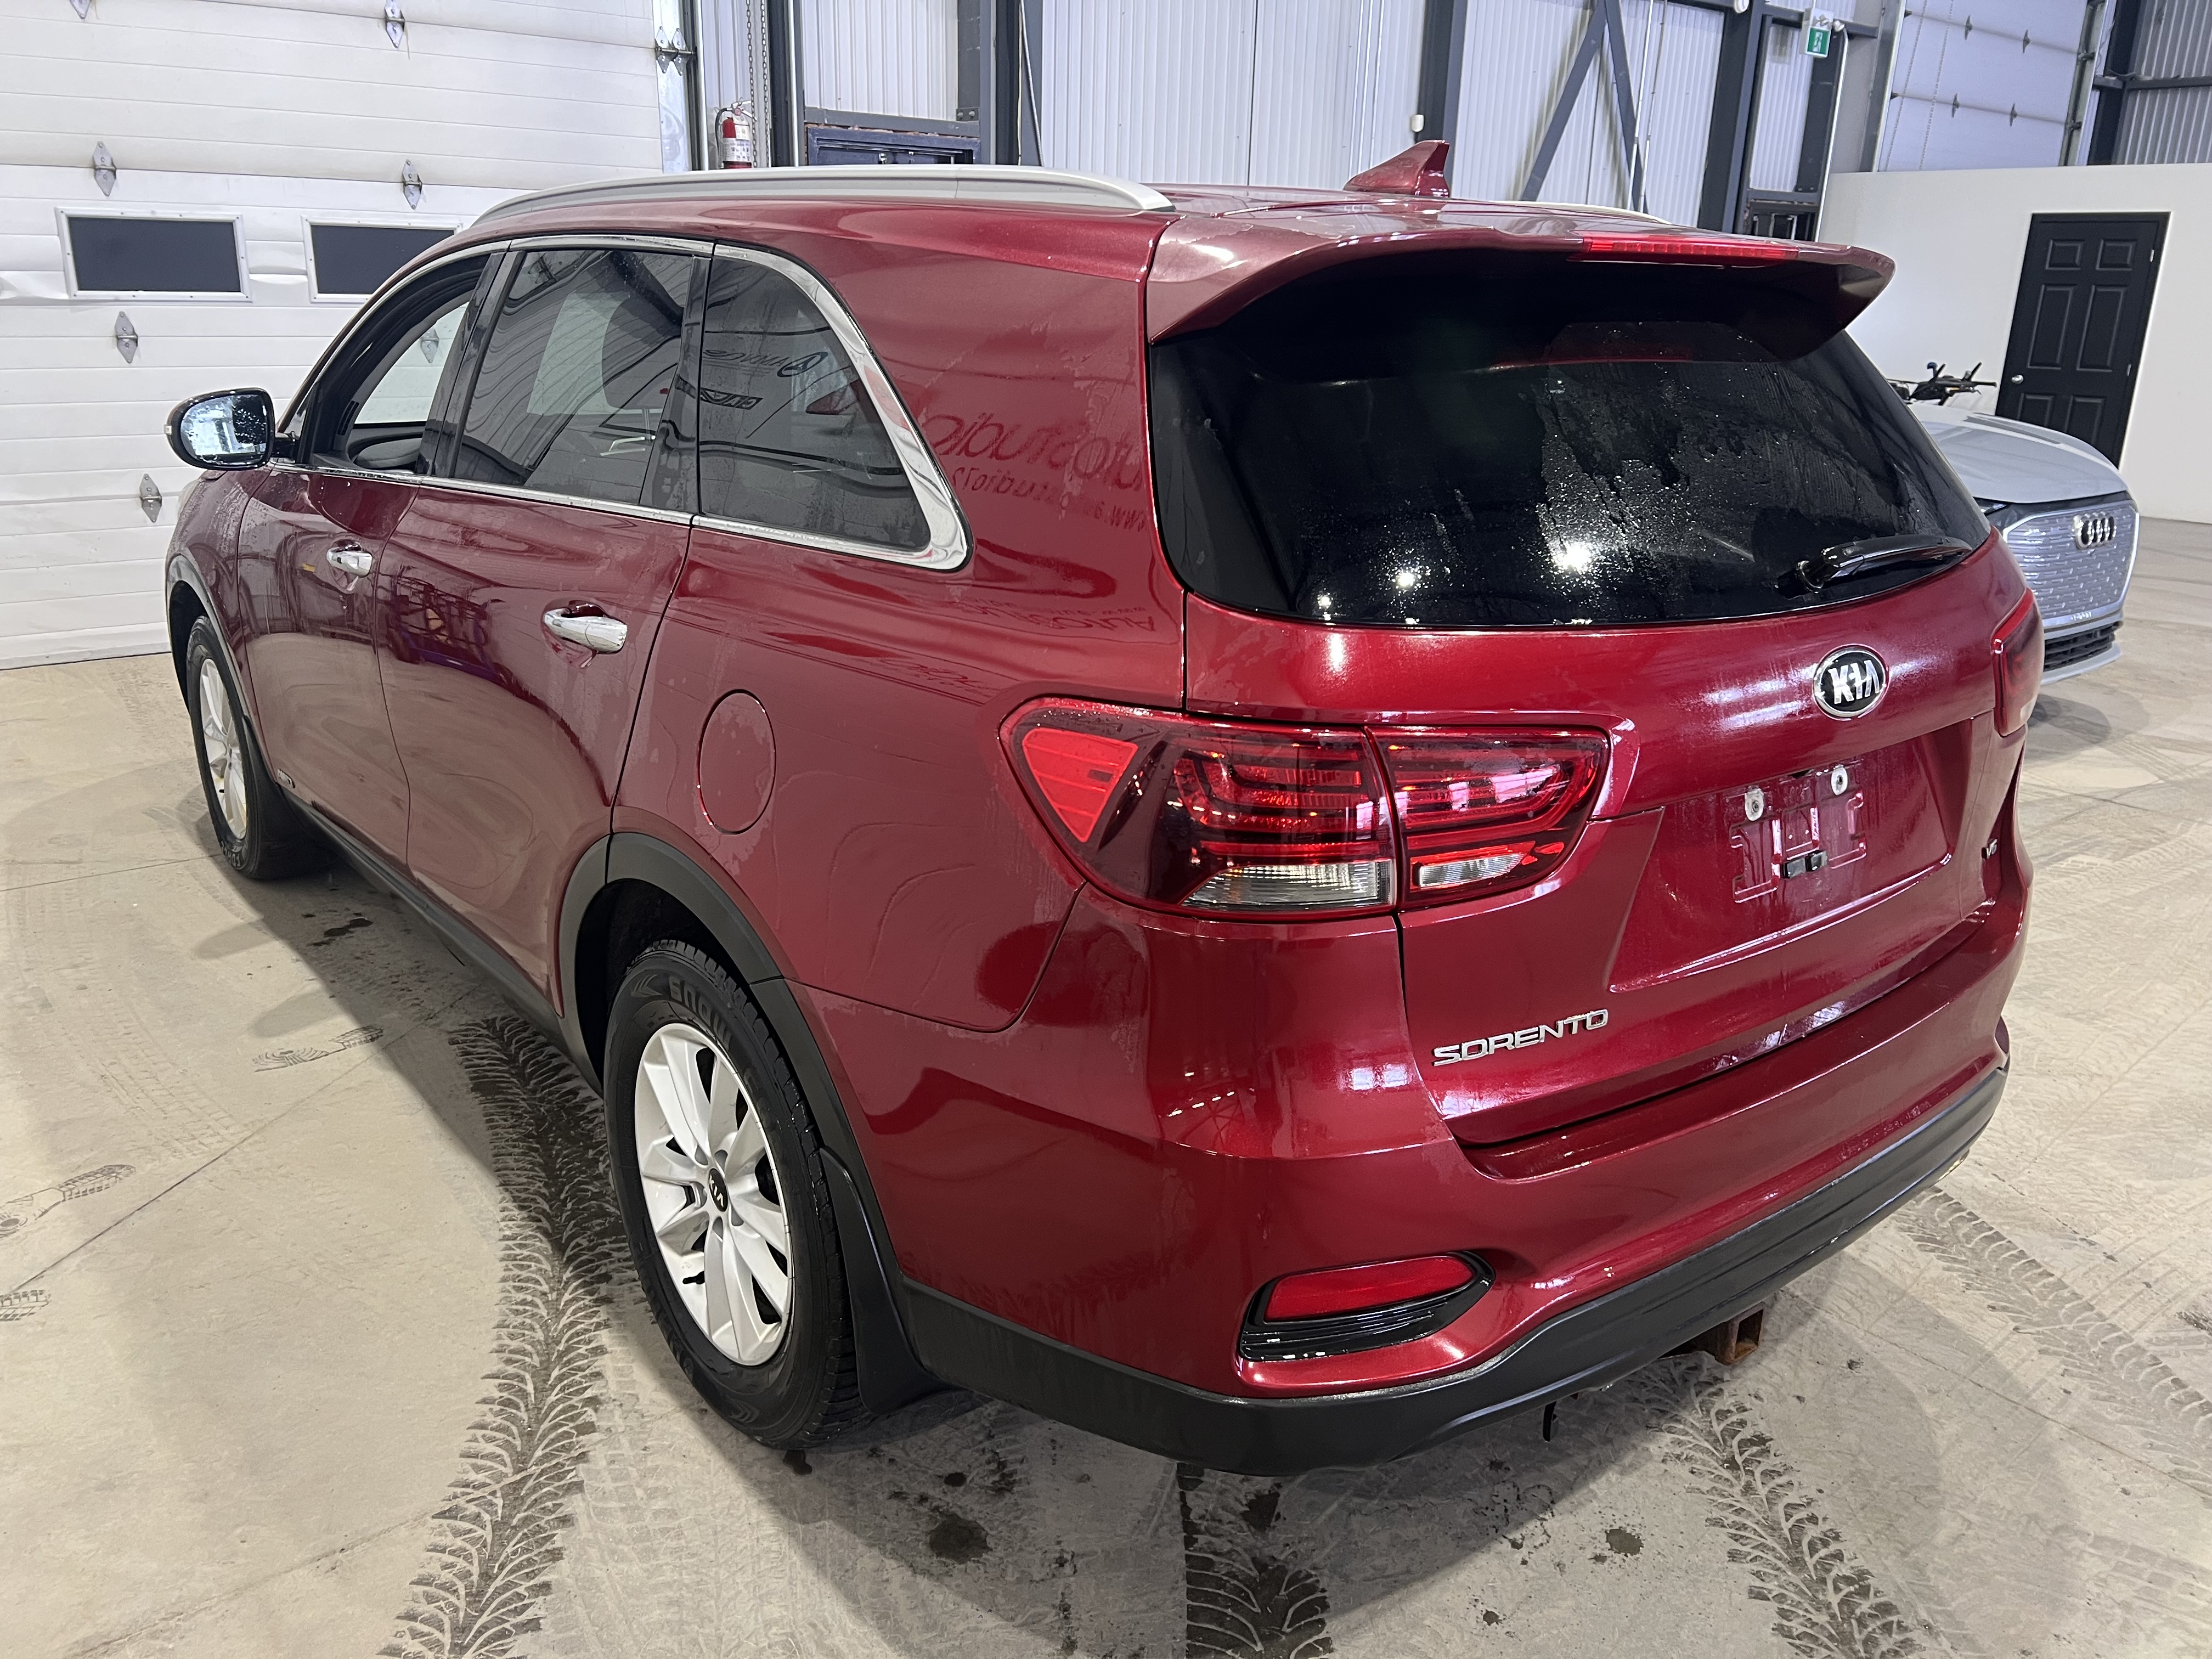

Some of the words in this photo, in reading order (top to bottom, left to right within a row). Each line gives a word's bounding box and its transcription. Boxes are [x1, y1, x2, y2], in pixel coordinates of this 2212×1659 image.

[1828, 659, 1880, 704] KIA
[1433, 1008, 1609, 1066] SORENTO
[709, 1174, 724, 1207] KIA
